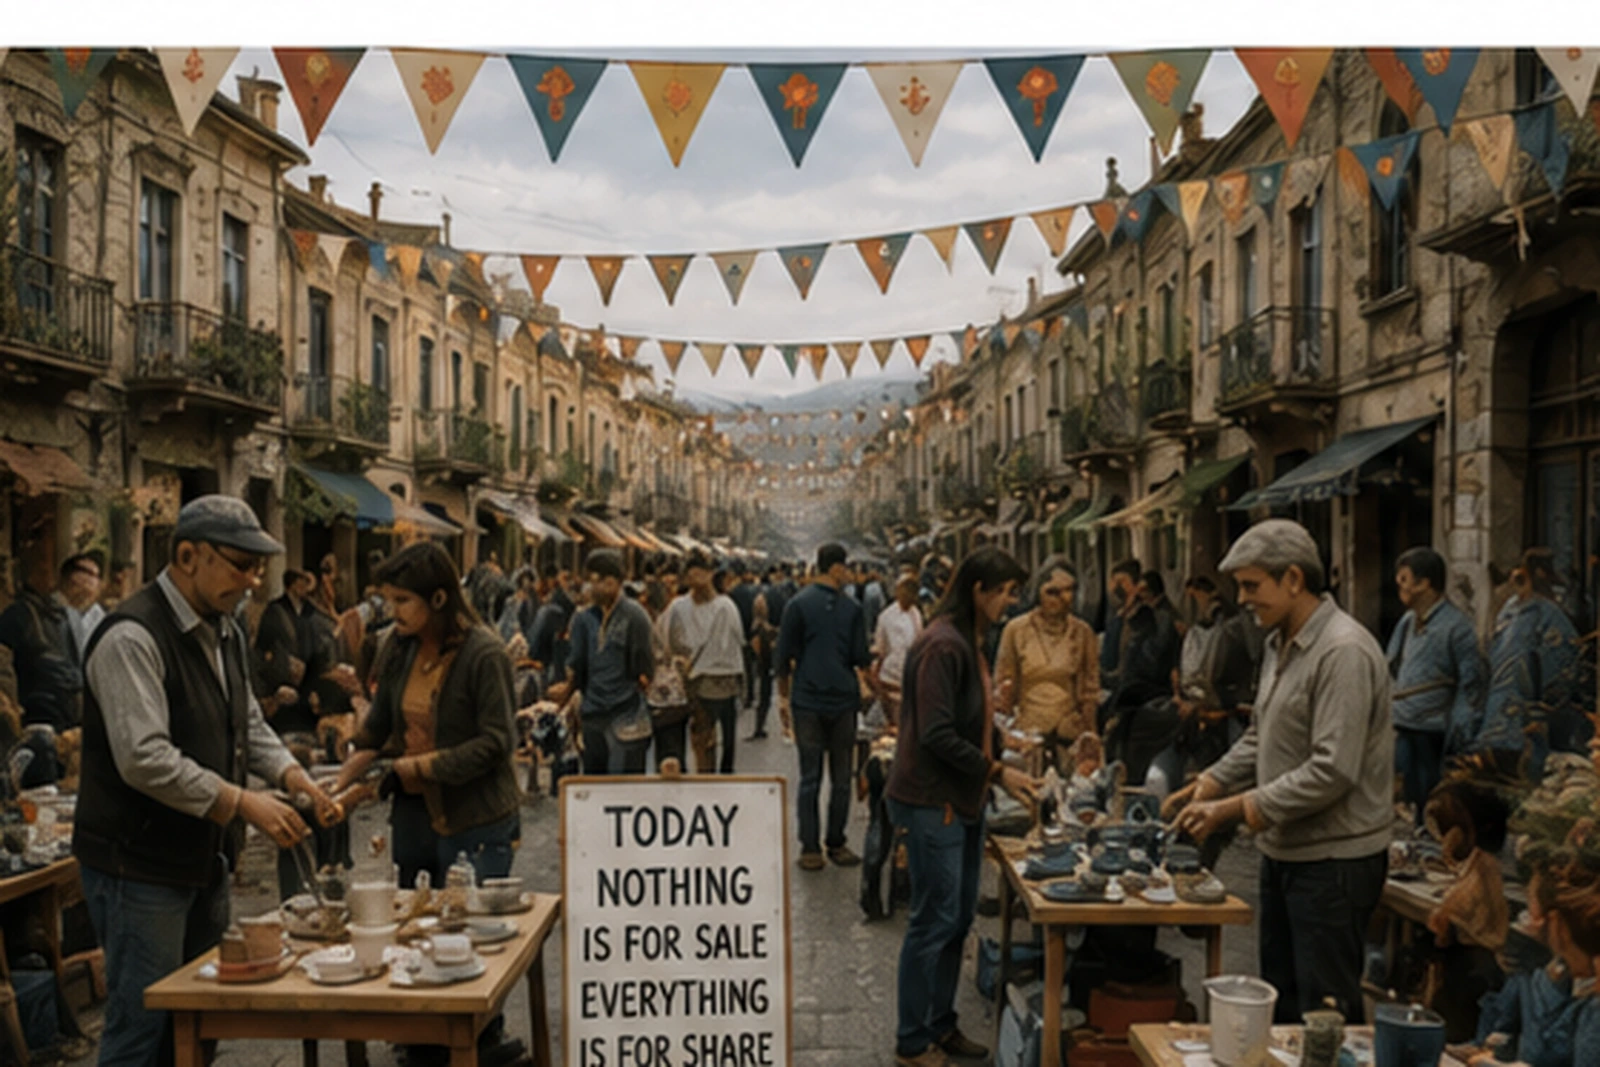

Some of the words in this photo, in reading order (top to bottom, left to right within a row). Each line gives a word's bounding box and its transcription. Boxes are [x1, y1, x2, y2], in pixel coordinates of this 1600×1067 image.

[604, 805, 738, 847] TODAY
[598, 866, 752, 907] NOTHING
[584, 926, 611, 961] IS
[625, 925, 682, 961] FOR
[696, 924, 767, 960] SALE
[582, 978, 769, 1019] EVERYTHING
[580, 1038, 606, 1067] IS
[618, 1035, 672, 1067] FOR
[683, 1032, 773, 1067] SHARE
